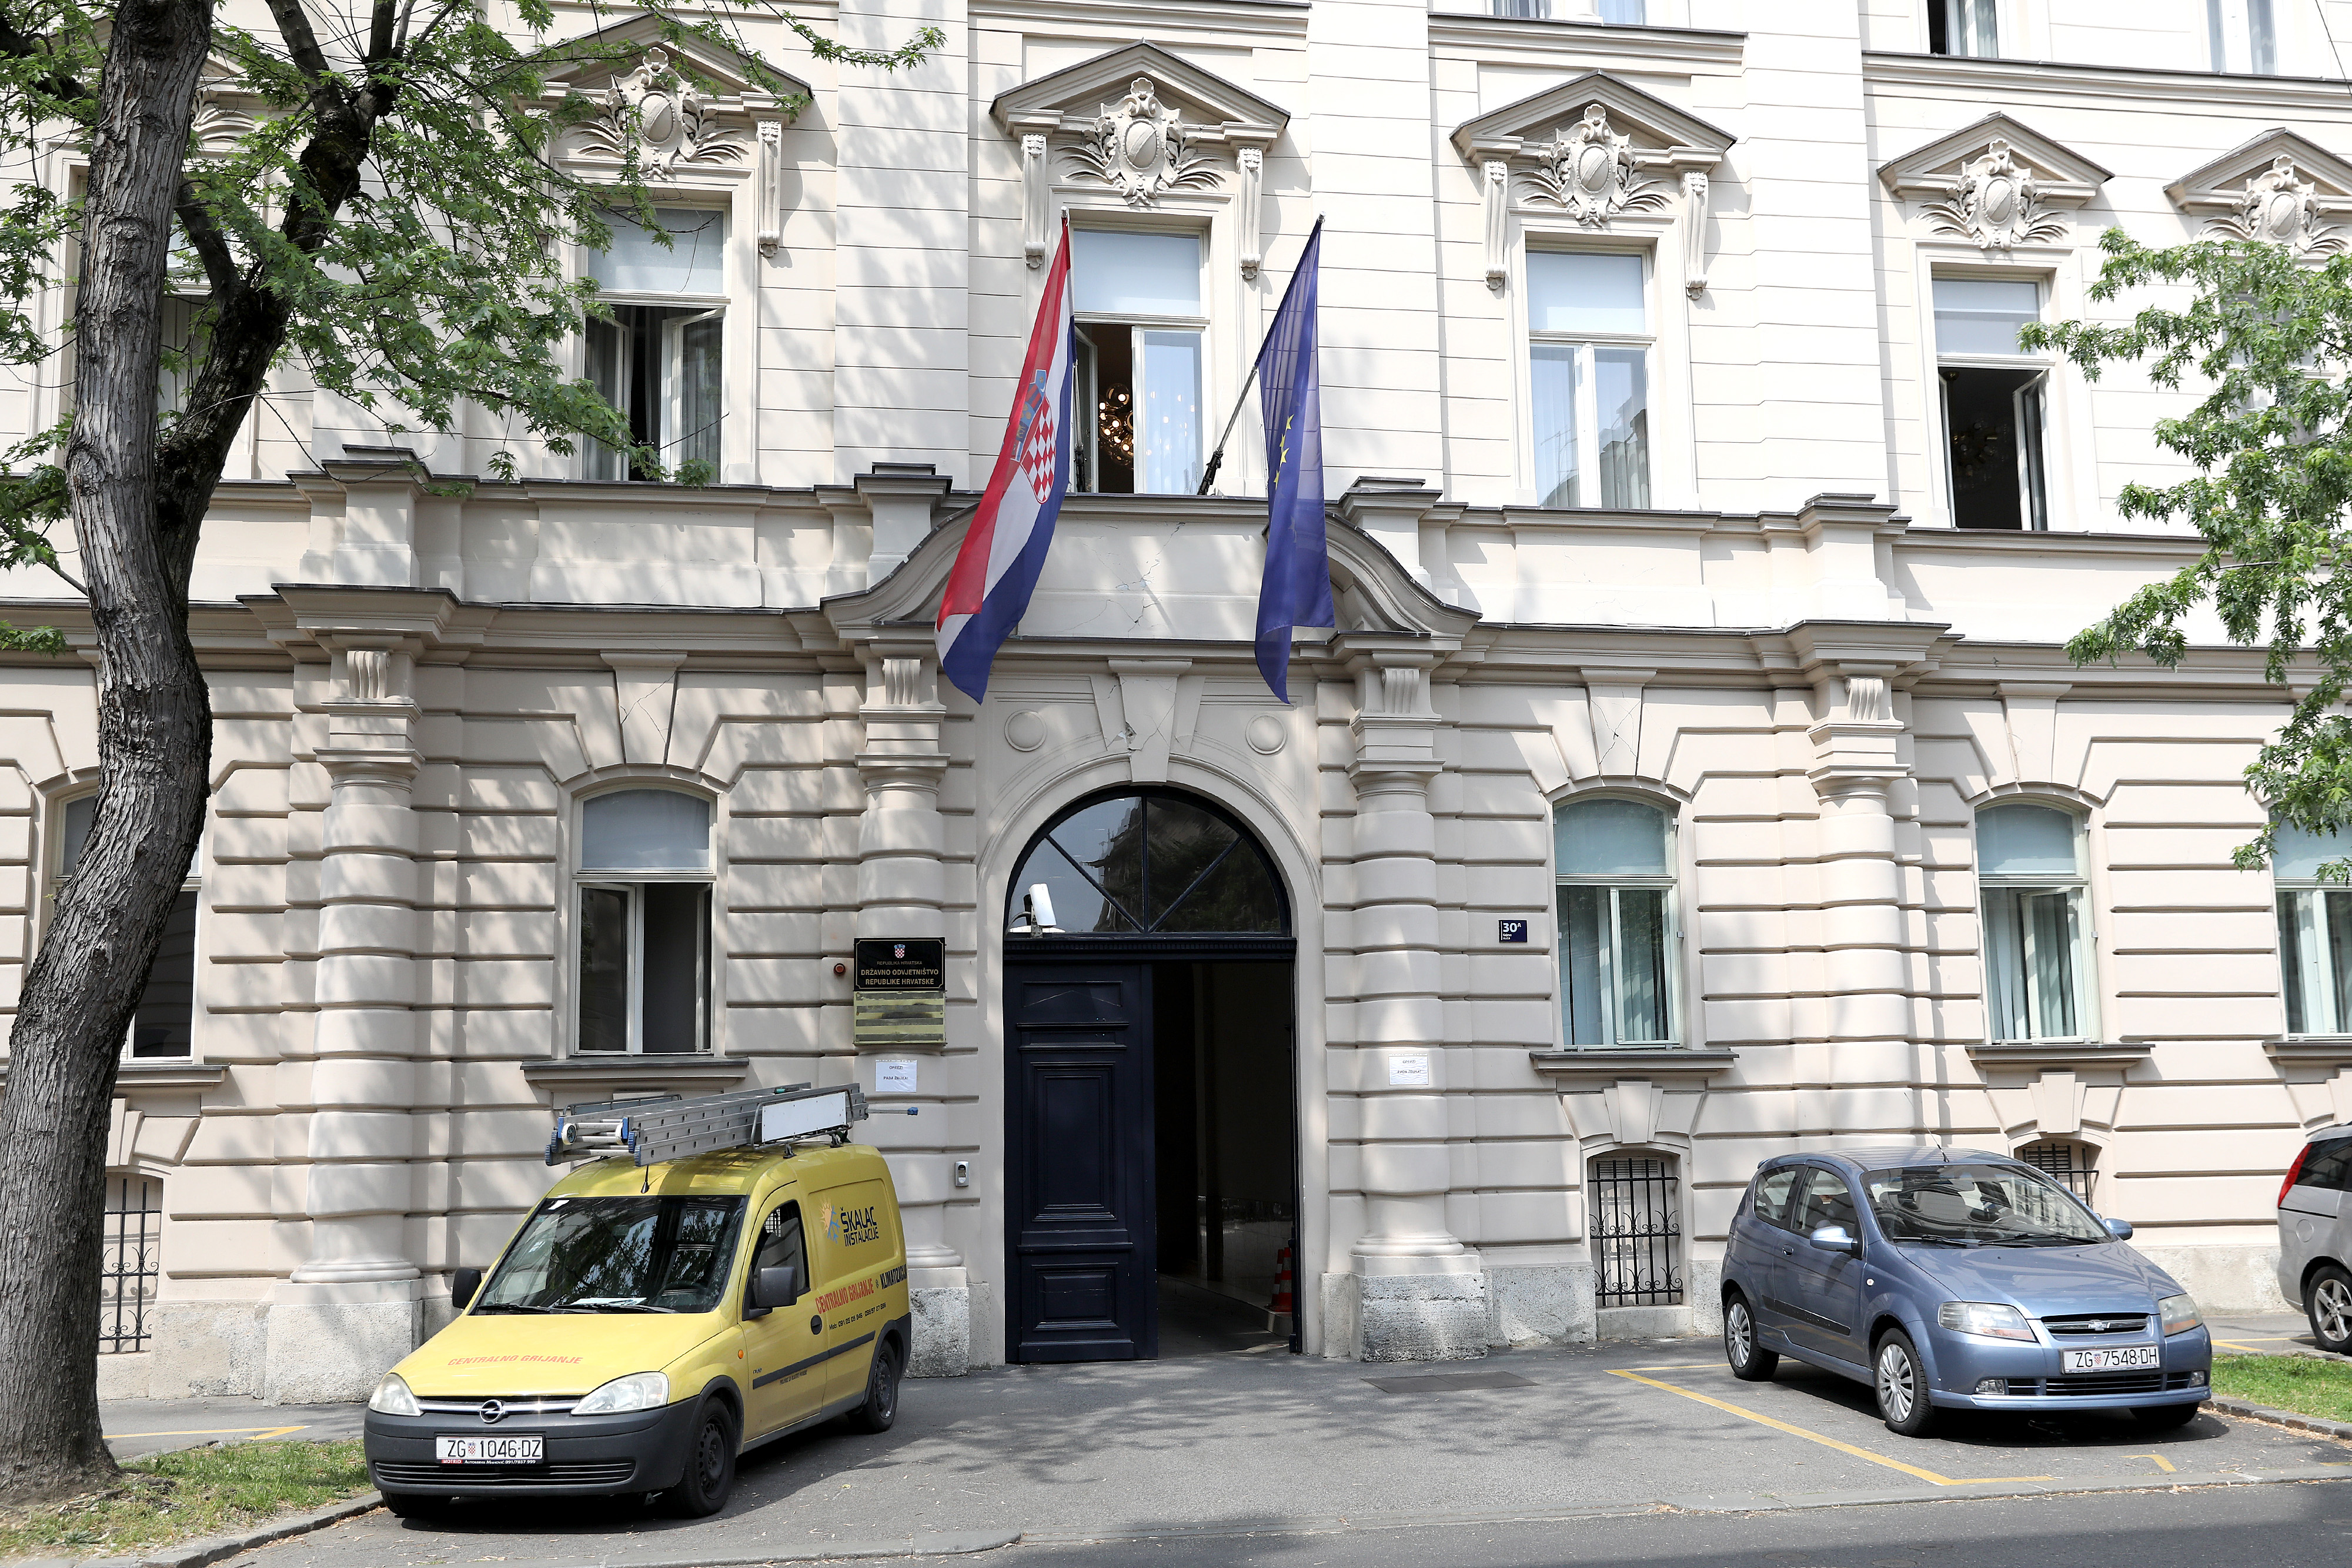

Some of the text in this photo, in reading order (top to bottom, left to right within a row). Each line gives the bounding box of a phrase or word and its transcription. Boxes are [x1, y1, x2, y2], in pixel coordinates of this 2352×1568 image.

[840, 1206, 877, 1233] ŠKALAC
[844, 1227, 879, 1247] INSTALACIJE
[815, 1287, 849, 1314] CENTRALNO
[848, 1278, 874, 1302] GRIJANJE
[447, 1355, 584, 1366] CENTRALNO GRIJANJE
[2075, 1352, 2093, 1368] ZG
[447, 1440, 466, 1457] ZG
